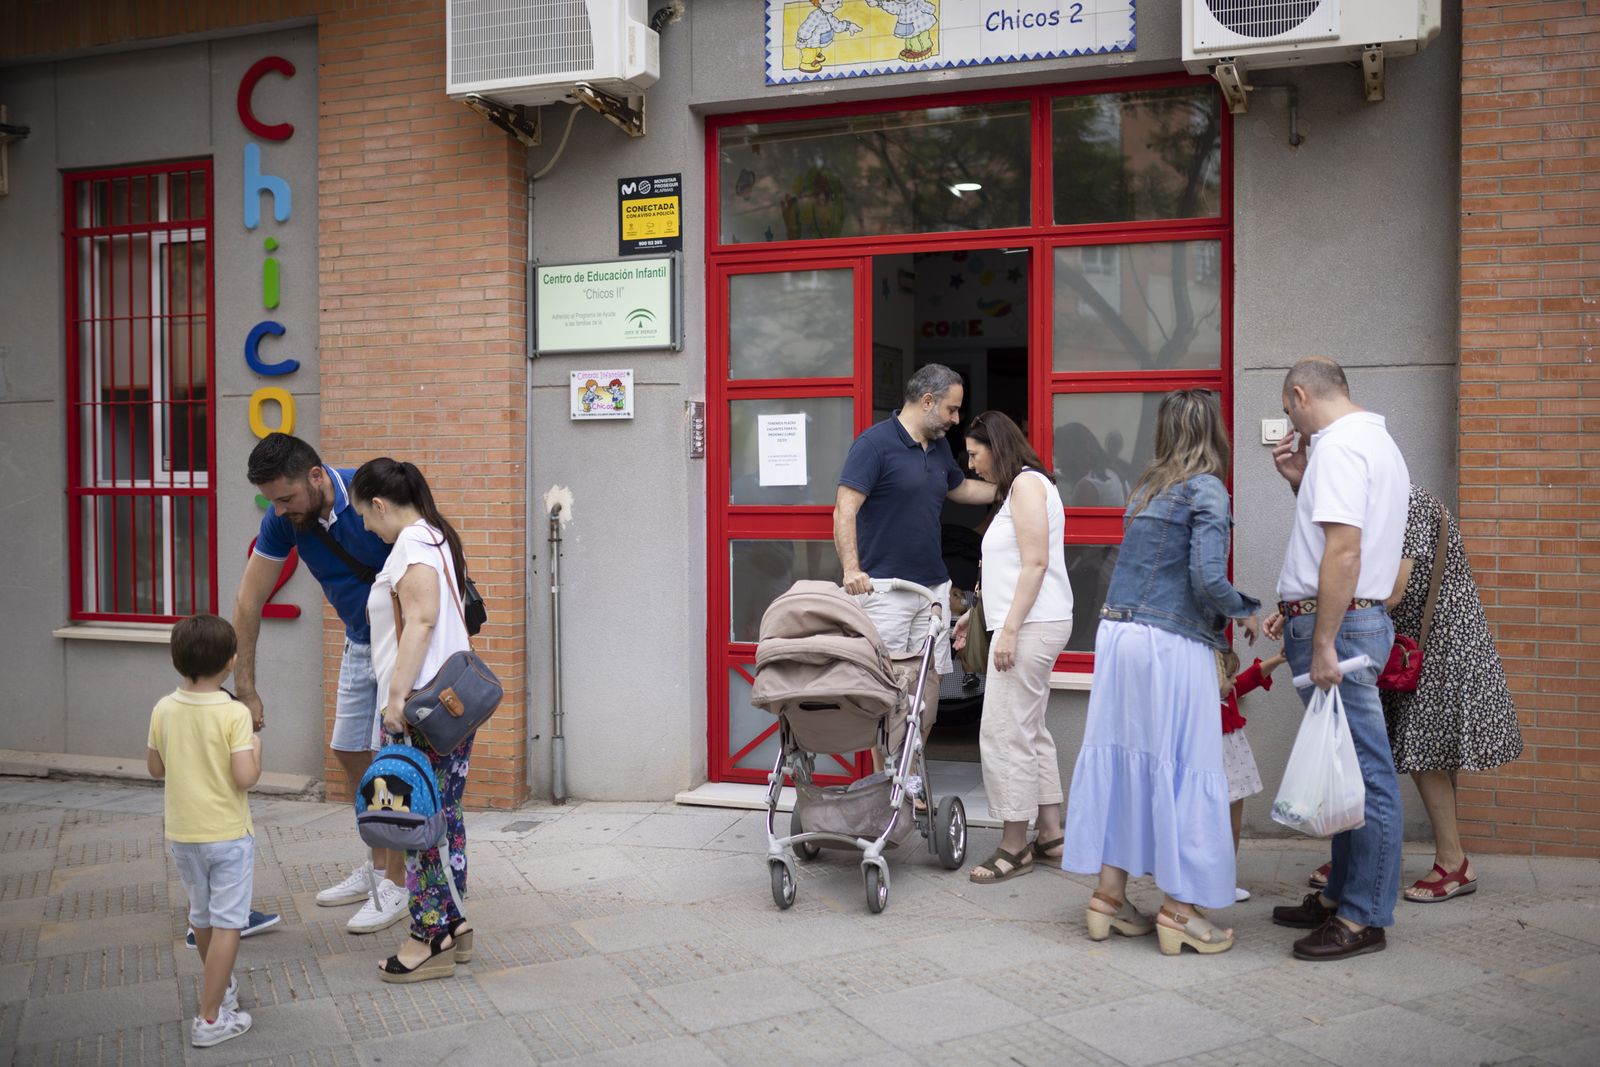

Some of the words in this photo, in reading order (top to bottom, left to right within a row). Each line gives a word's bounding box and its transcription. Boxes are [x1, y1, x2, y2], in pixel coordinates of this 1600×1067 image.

[985, 9, 1060, 32] Chicos
[1070, 2, 1083, 23] 2
[626, 203, 675, 213] CONECTADA
[237, 56, 300, 510] Chico
[543, 274, 572, 285] Centro
[574, 272, 585, 283] de
[587, 268, 633, 282] Educación
[635, 266, 667, 279] Infantil
[591, 402, 613, 410] Chicos
